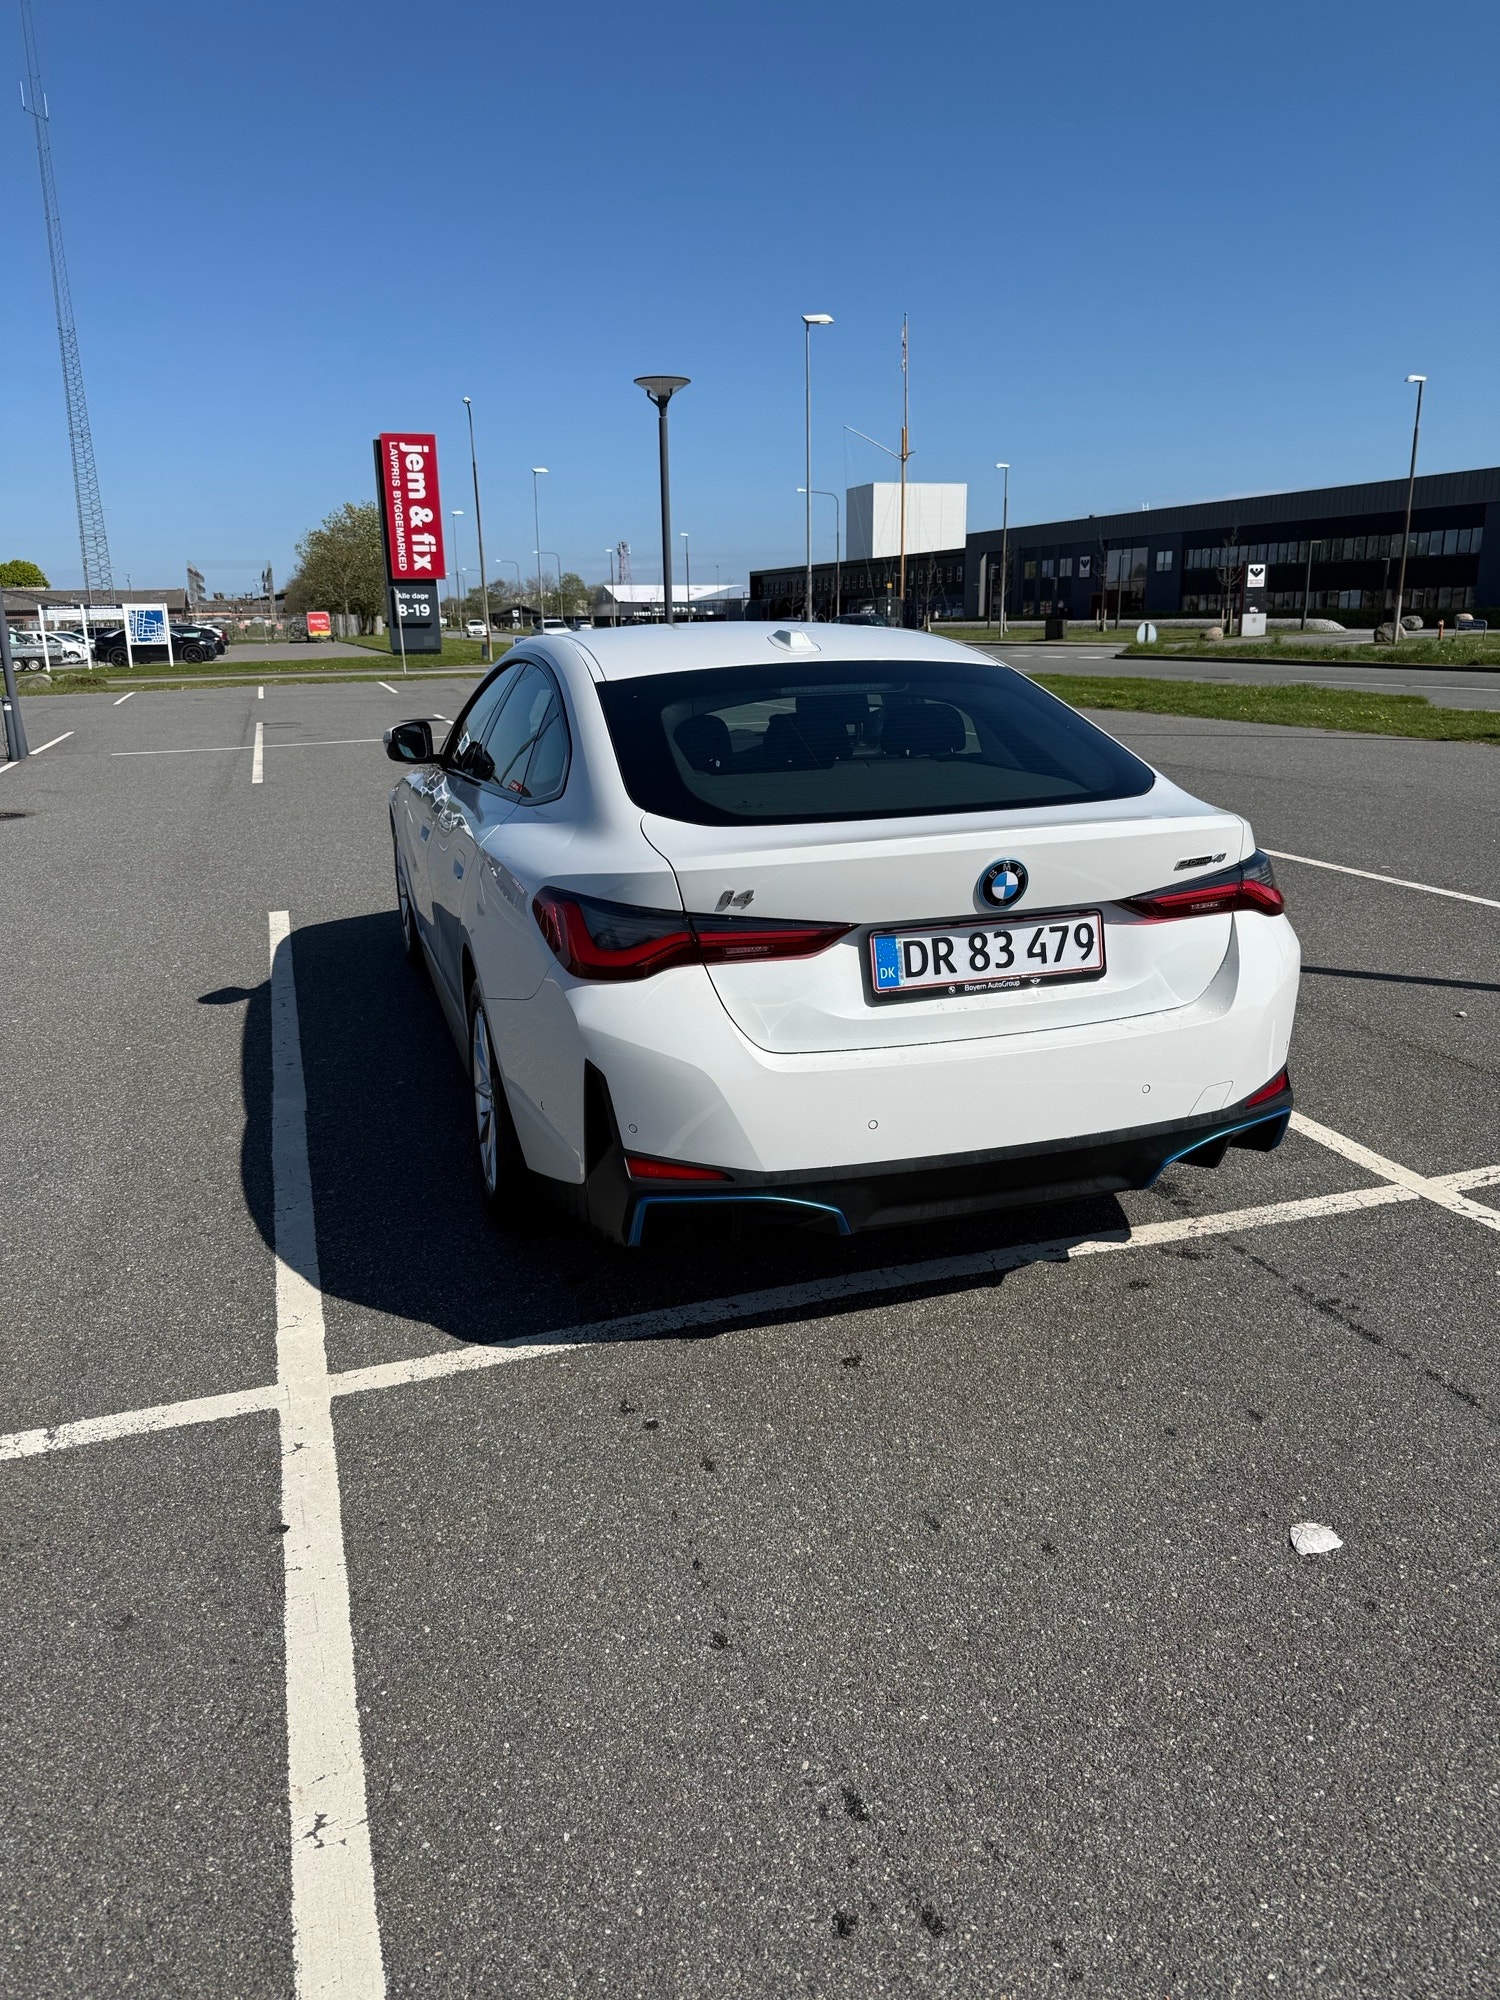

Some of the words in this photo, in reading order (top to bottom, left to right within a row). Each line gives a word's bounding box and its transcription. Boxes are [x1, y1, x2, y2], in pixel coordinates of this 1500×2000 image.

[389, 441, 401, 487] LAVPRIS
[399, 442, 430, 499] jem
[409, 505, 434, 529] &
[392, 490, 408, 571] BYGGEMARKED
[411, 533, 437, 571] fix
[411, 592, 429, 600] dage
[399, 603, 431, 617] 8-19
[988, 862, 1024, 880] BMW
[713, 889, 755, 912] i4
[903, 936, 958, 979] DR
[968, 930, 1015, 972] 83
[1026, 922, 1095, 965] 479
[880, 966, 896, 979] DK
[964, 983, 987, 992] Bayern
[987, 979, 1021, 989] AutoGroup
